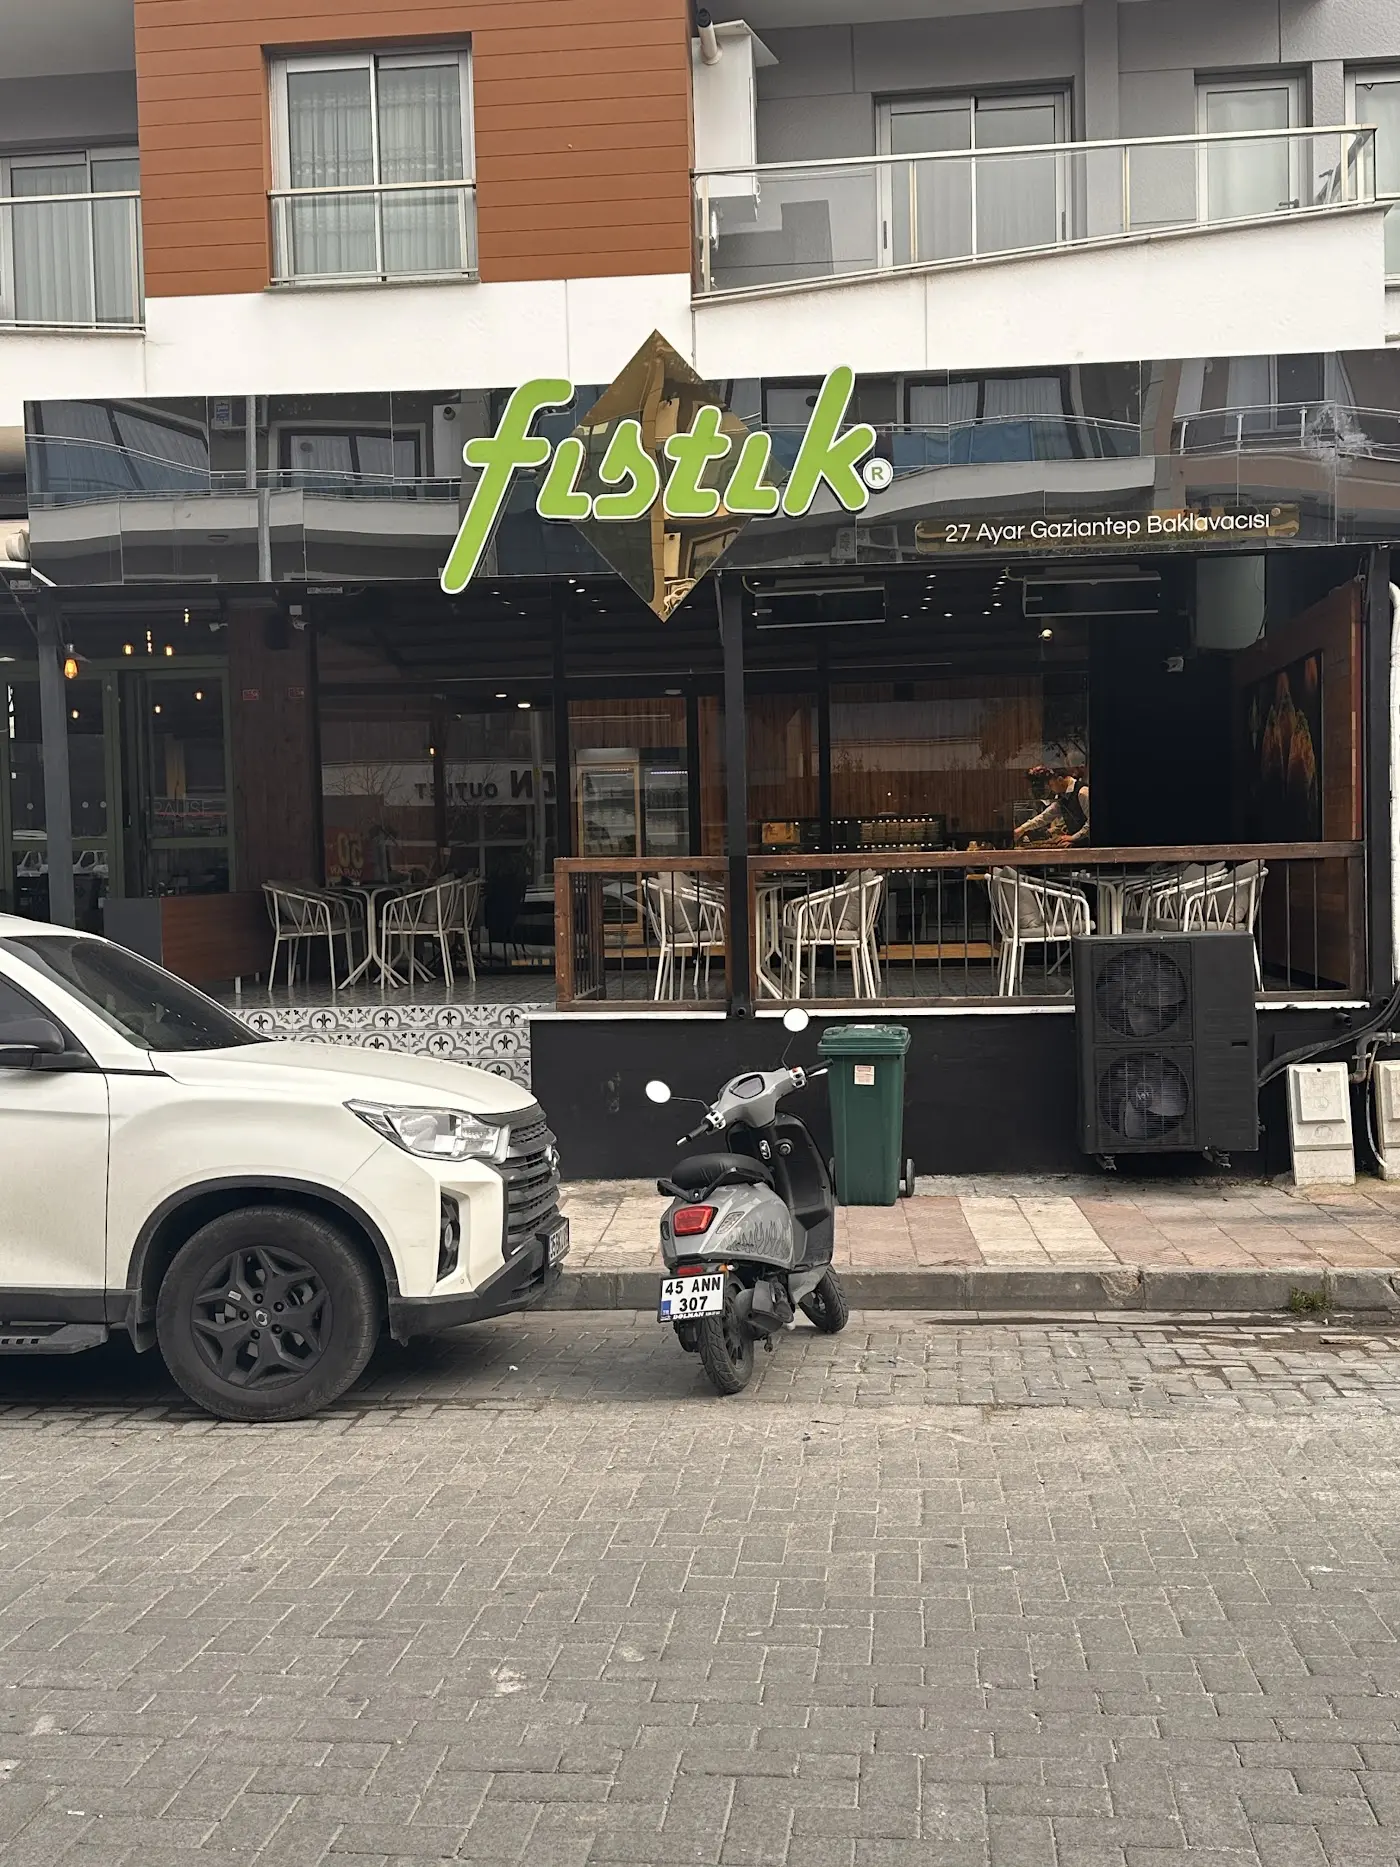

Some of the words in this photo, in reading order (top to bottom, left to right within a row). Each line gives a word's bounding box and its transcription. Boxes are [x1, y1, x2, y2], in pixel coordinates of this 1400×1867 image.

[945, 524, 971, 542] 27
[976, 523, 1026, 545] Ayar
[1030, 517, 1141, 539] Gaziantep
[1147, 513, 1270, 534] Baklavacısı
[665, 1280, 684, 1295] 45
[691, 1276, 721, 1293] ANN
[679, 1295, 708, 1312] 307
